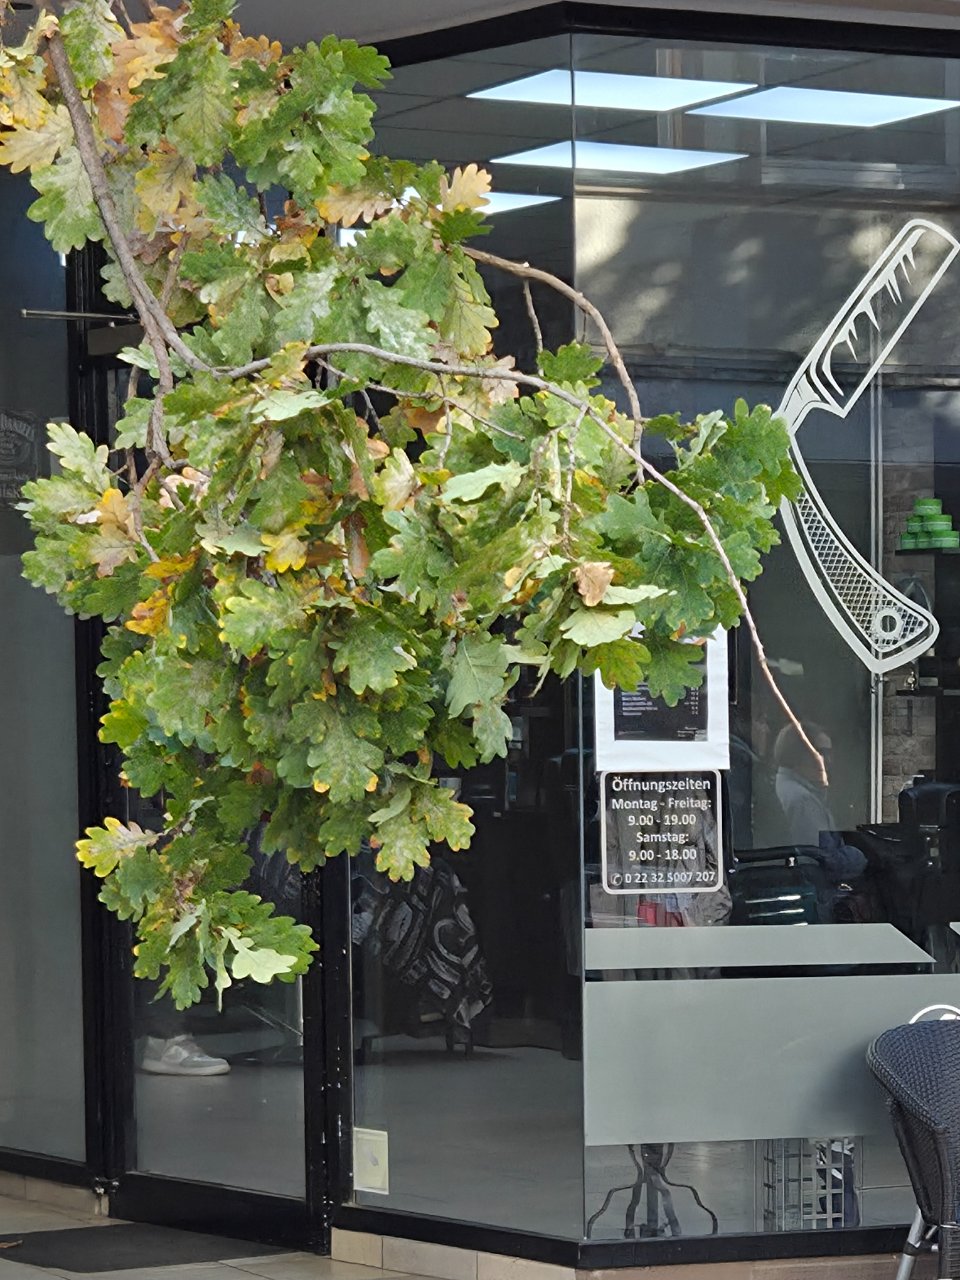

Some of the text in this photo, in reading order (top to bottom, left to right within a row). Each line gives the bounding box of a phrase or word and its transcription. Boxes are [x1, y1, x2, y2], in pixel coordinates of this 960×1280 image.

[612, 776, 711, 793] Öffnungszeiten
[611, 798, 658, 812] Montag
[668, 797, 712, 811] Freitag:
[628, 814, 654, 826] 9.00
[664, 814, 697, 826] 19.00
[636, 831, 689, 844] Samstag:
[628, 849, 655, 861] 9.00
[664, 848, 697, 860] 18.00
[625, 871, 716, 884] 0 22 32 5007 207
